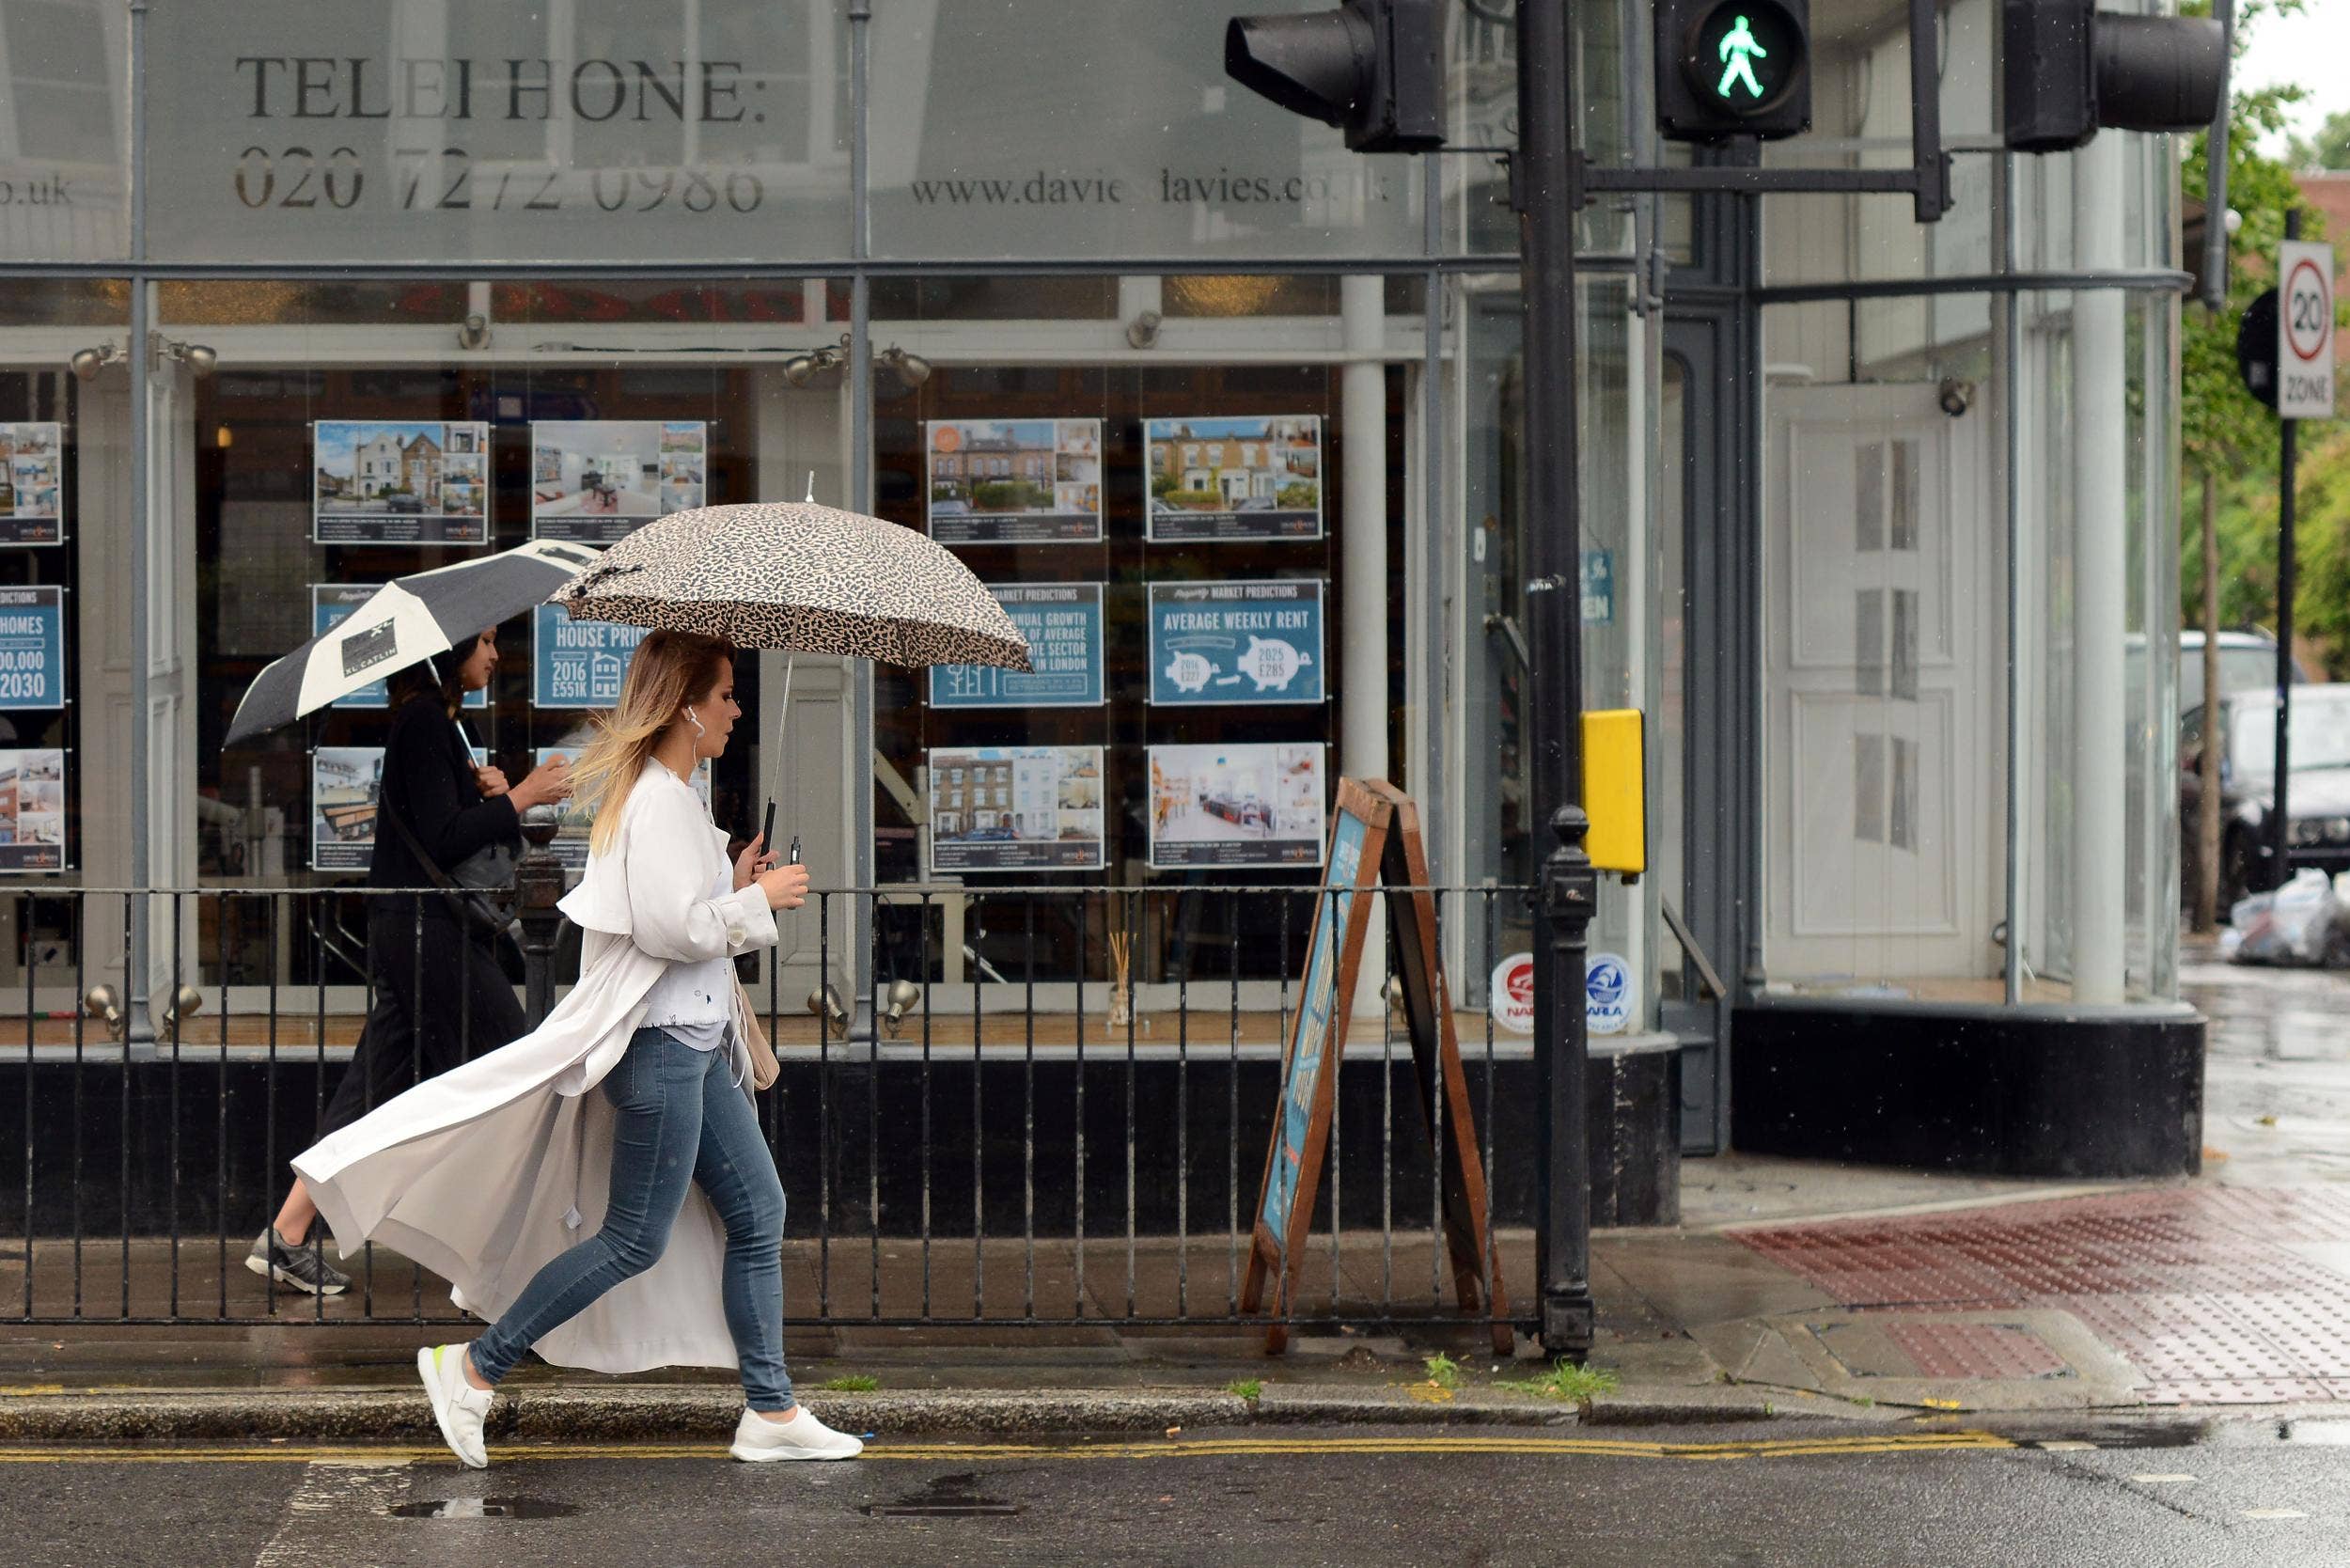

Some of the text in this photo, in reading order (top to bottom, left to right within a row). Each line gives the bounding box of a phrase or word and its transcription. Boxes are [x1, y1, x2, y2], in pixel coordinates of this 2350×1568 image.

[235, 147, 364, 209] 020
[0, 175, 73, 205] o.uk
[2295, 291, 2323, 331] 20
[2287, 376, 2327, 403] ZONE
[0, 592, 38, 604] DICTIONS
[1026, 588, 1078, 601] PREDICTIONS
[1211, 587, 1244, 599] MARKET
[1246, 586, 1298, 598] PREDICTIONS
[0, 617, 43, 634] HOMES
[1009, 612, 1088, 625] NNUAL GROWTH
[1164, 611, 1309, 631] AVERAGE WEEKLY RENT
[556, 627, 605, 647] HOUSE
[1030, 628, 1042, 640] OF
[1044, 627, 1087, 641] AVERAGE
[1049, 643, 1088, 656] SECTOR
[1259, 648, 1284, 662] 2025
[553, 662, 587, 681] 2016
[1036, 658, 1088, 670] IN LONDON
[1259, 664, 1285, 678] £285
[0, 673, 45, 698] 2030
[553, 682, 588, 698] £551K
